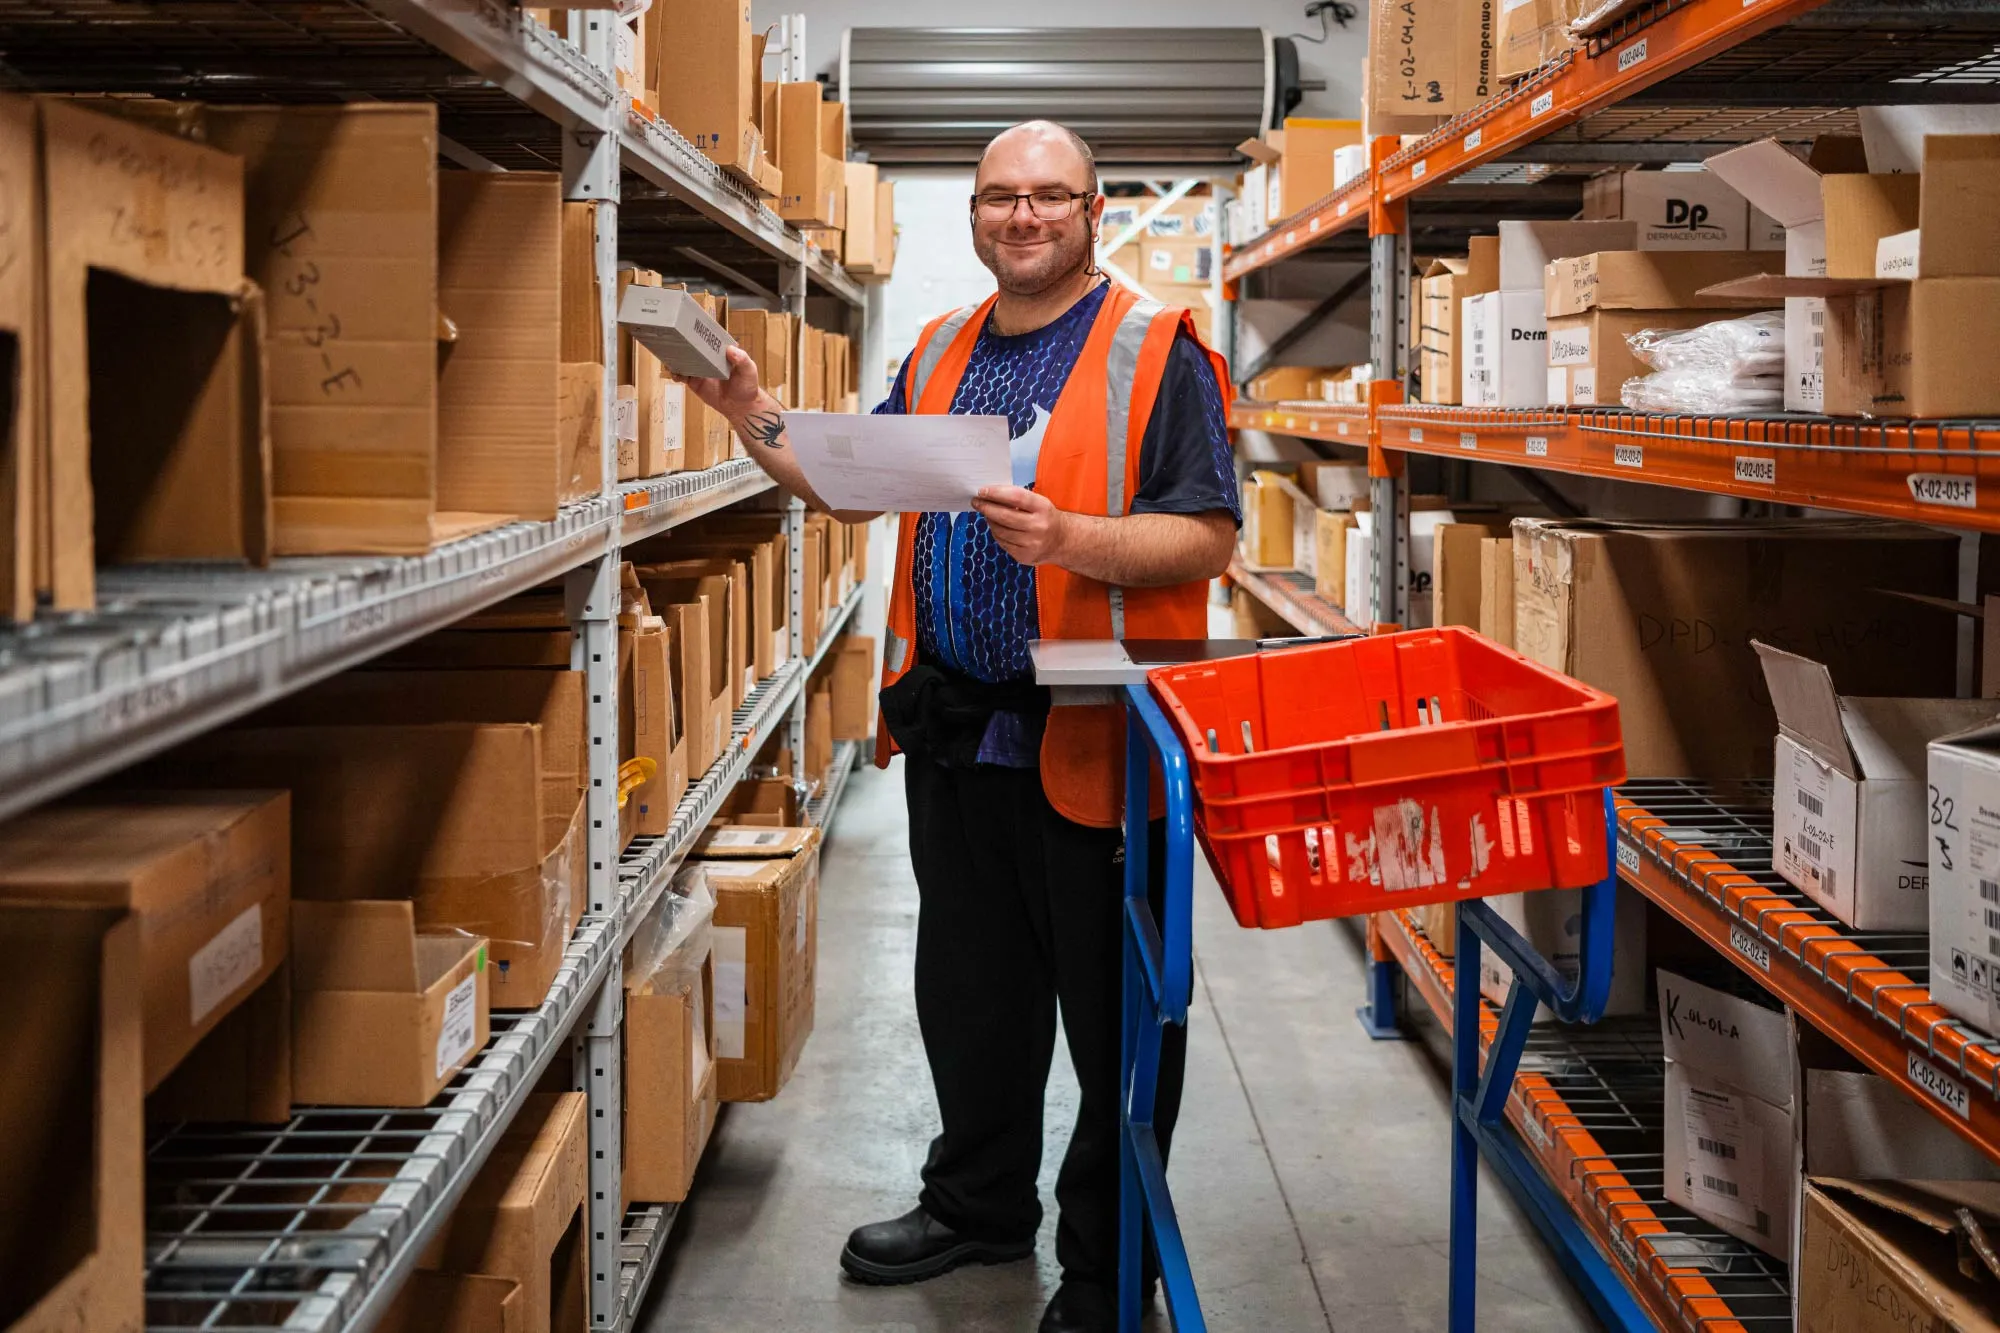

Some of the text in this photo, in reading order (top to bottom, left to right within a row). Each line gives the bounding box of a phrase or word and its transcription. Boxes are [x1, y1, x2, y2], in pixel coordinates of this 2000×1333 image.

[1476, 0, 1492, 96] Dermapenwo
[1619, 44, 1645, 68] K-02-04-D
[1646, 231, 1727, 241] DERMACEUTICALS
[694, 319, 722, 354] WAYFARER
[1511, 328, 1547, 341] Derm
[1615, 448, 1642, 463] K-02-03-D
[1736, 461, 1773, 480] K-02-03-E
[1913, 478, 1972, 502] K-02-03-F
[1617, 844, 1639, 870] -02-02-D
[1731, 928, 1768, 967] K-02-02-E
[1910, 1056, 1965, 1108] K-02-02-F
